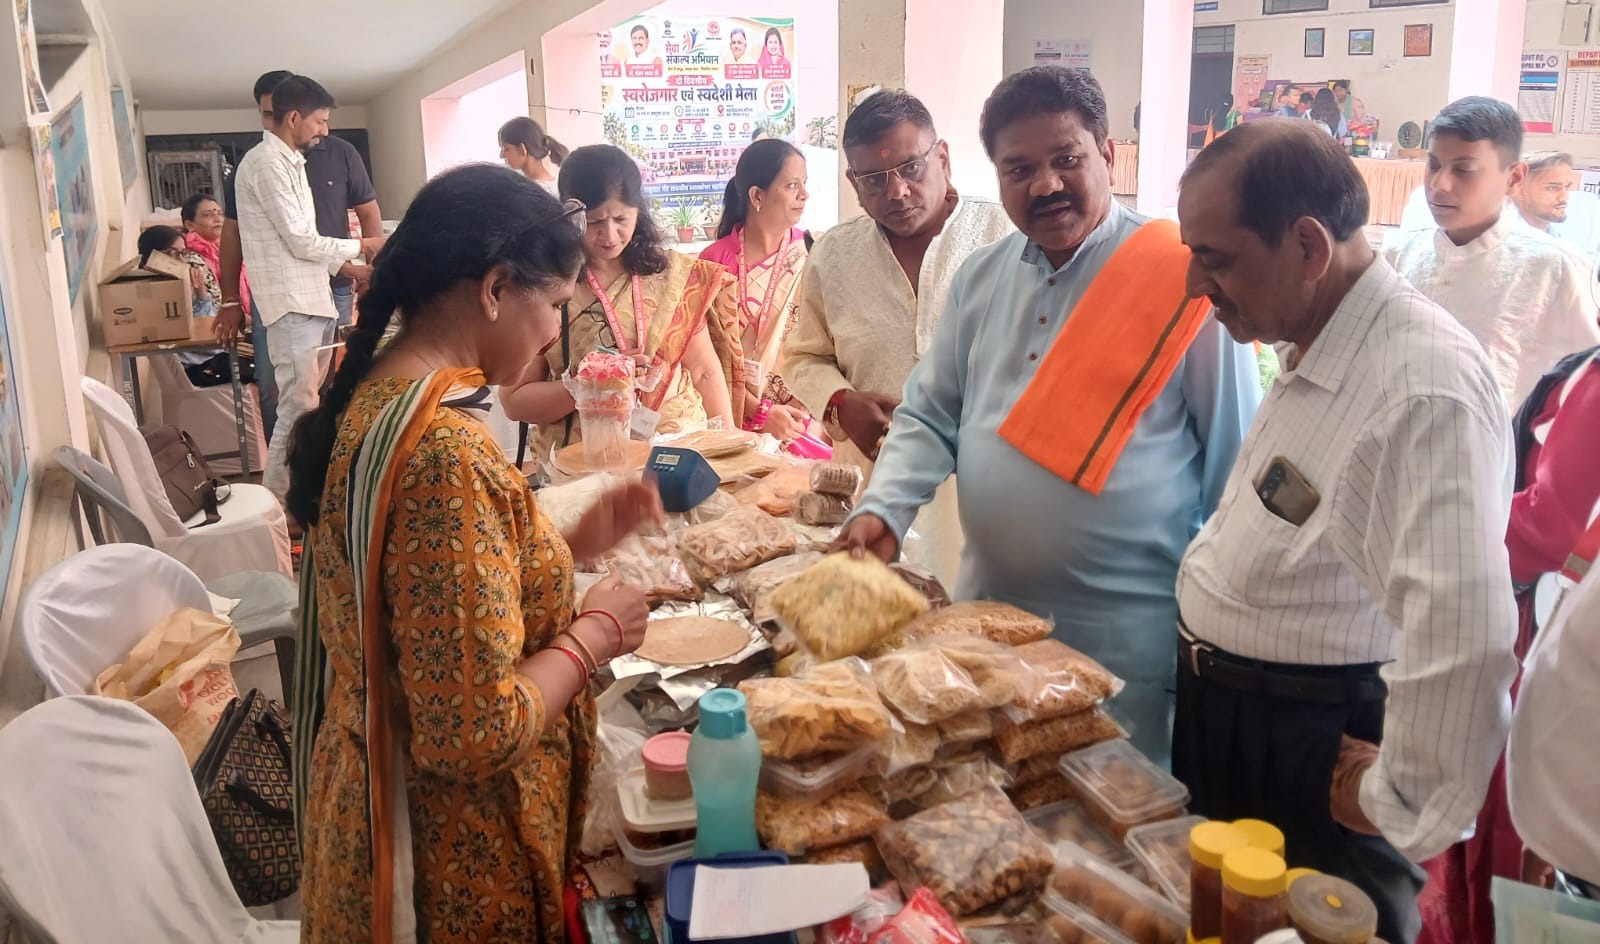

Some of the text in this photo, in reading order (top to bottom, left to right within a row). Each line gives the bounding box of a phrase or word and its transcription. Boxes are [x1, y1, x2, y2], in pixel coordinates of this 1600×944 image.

[665, 40, 679, 54] सेवा
[691, 52, 719, 64] अभियान
[684, 76, 707, 85] दिवसीय
[622, 82, 679, 102] स्वरोजगार
[681, 87, 694, 101] एवं
[697, 83, 733, 102] स्वदेशी
[735, 83, 758, 101] मेला
